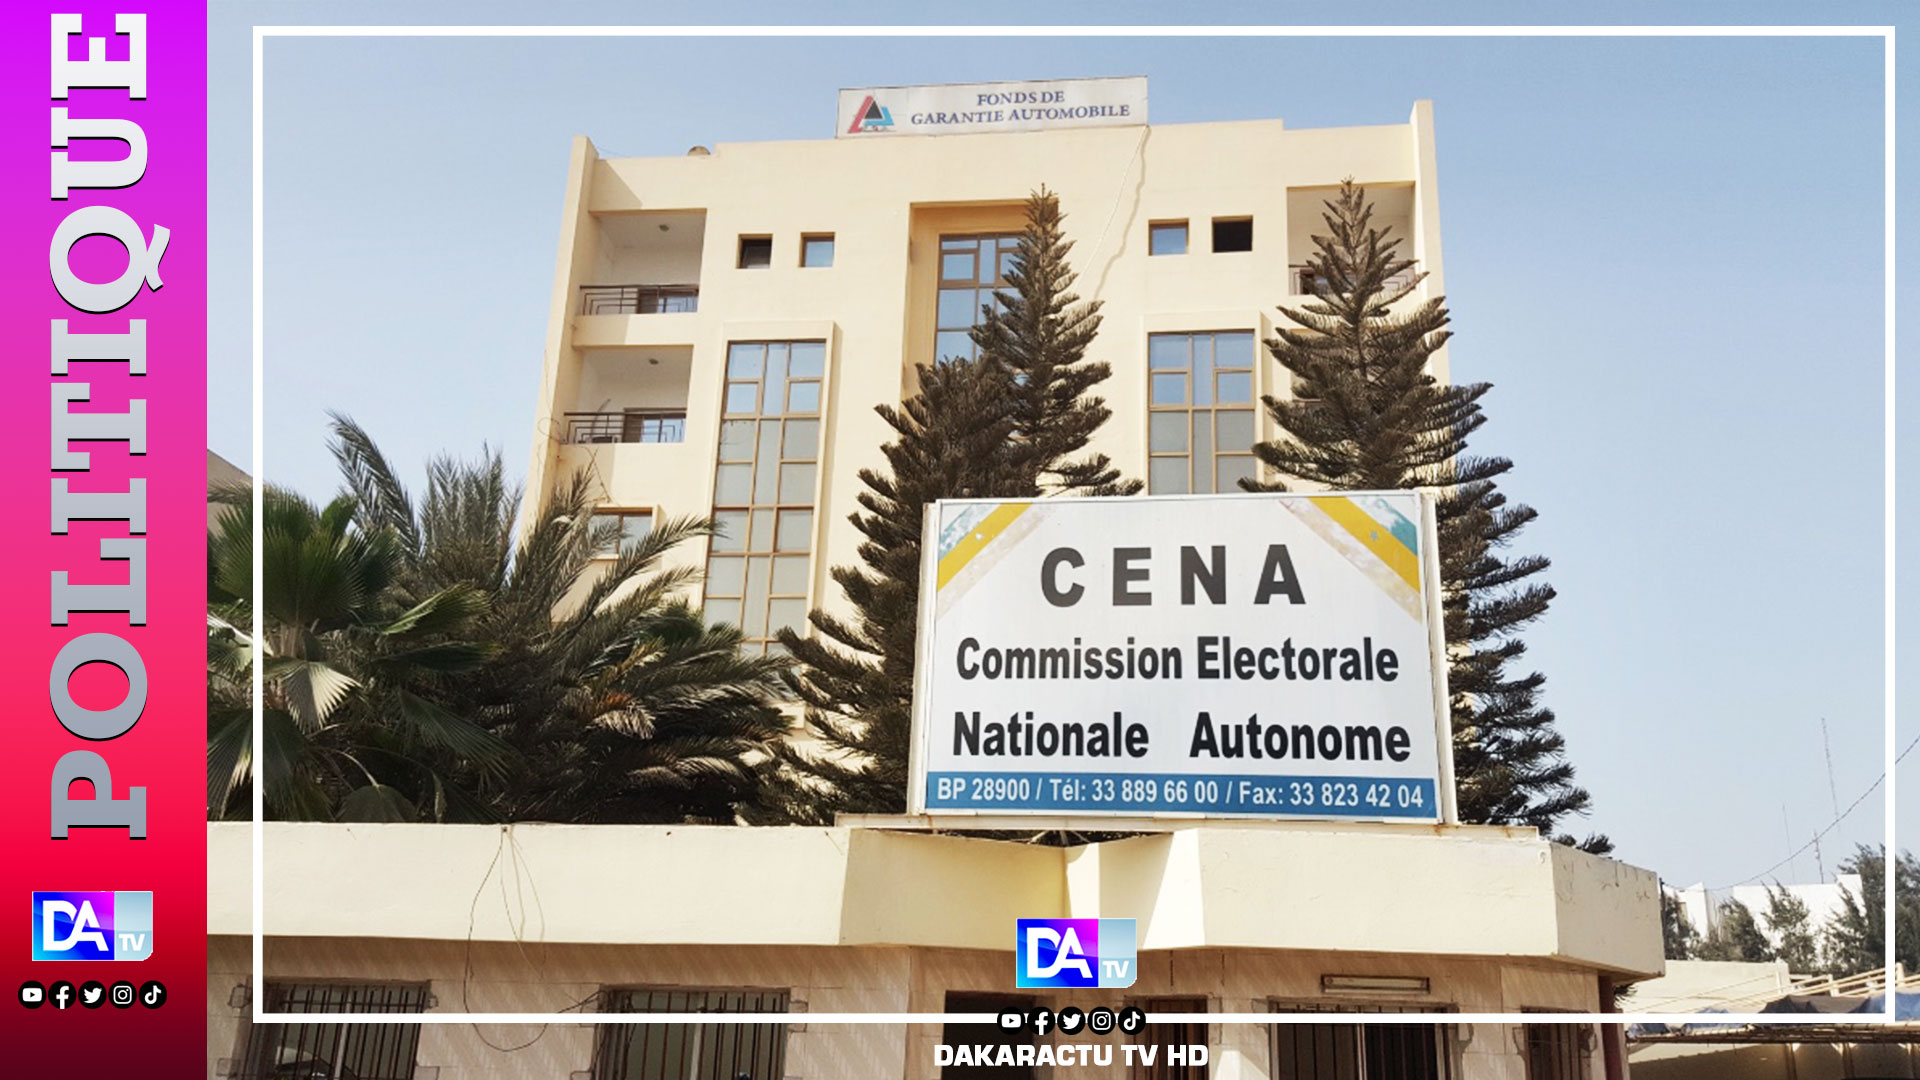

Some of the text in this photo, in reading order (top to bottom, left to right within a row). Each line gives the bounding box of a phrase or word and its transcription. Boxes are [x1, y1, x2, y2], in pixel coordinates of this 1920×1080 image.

[977, 91, 1065, 106] FONDS DE
[911, 105, 1130, 125] GARANTIE AUTOMOBILE
[956, 636, 1399, 681] Commission Electorale
[953, 711, 1411, 761] Nationale Autonome
[937, 778, 966, 800] BP
[971, 778, 1030, 800] 28900
[1049, 778, 1086, 801] Tél:
[1092, 779, 1115, 802] 33
[1121, 779, 1157, 803] 889
[1164, 780, 1187, 803] 66
[1194, 780, 1218, 803] 00
[1239, 781, 1283, 805] Fax:
[1290, 782, 1314, 806] 33
[1321, 783, 1358, 806] 823
[1366, 784, 1390, 807] 42
[1398, 785, 1423, 808] 04
